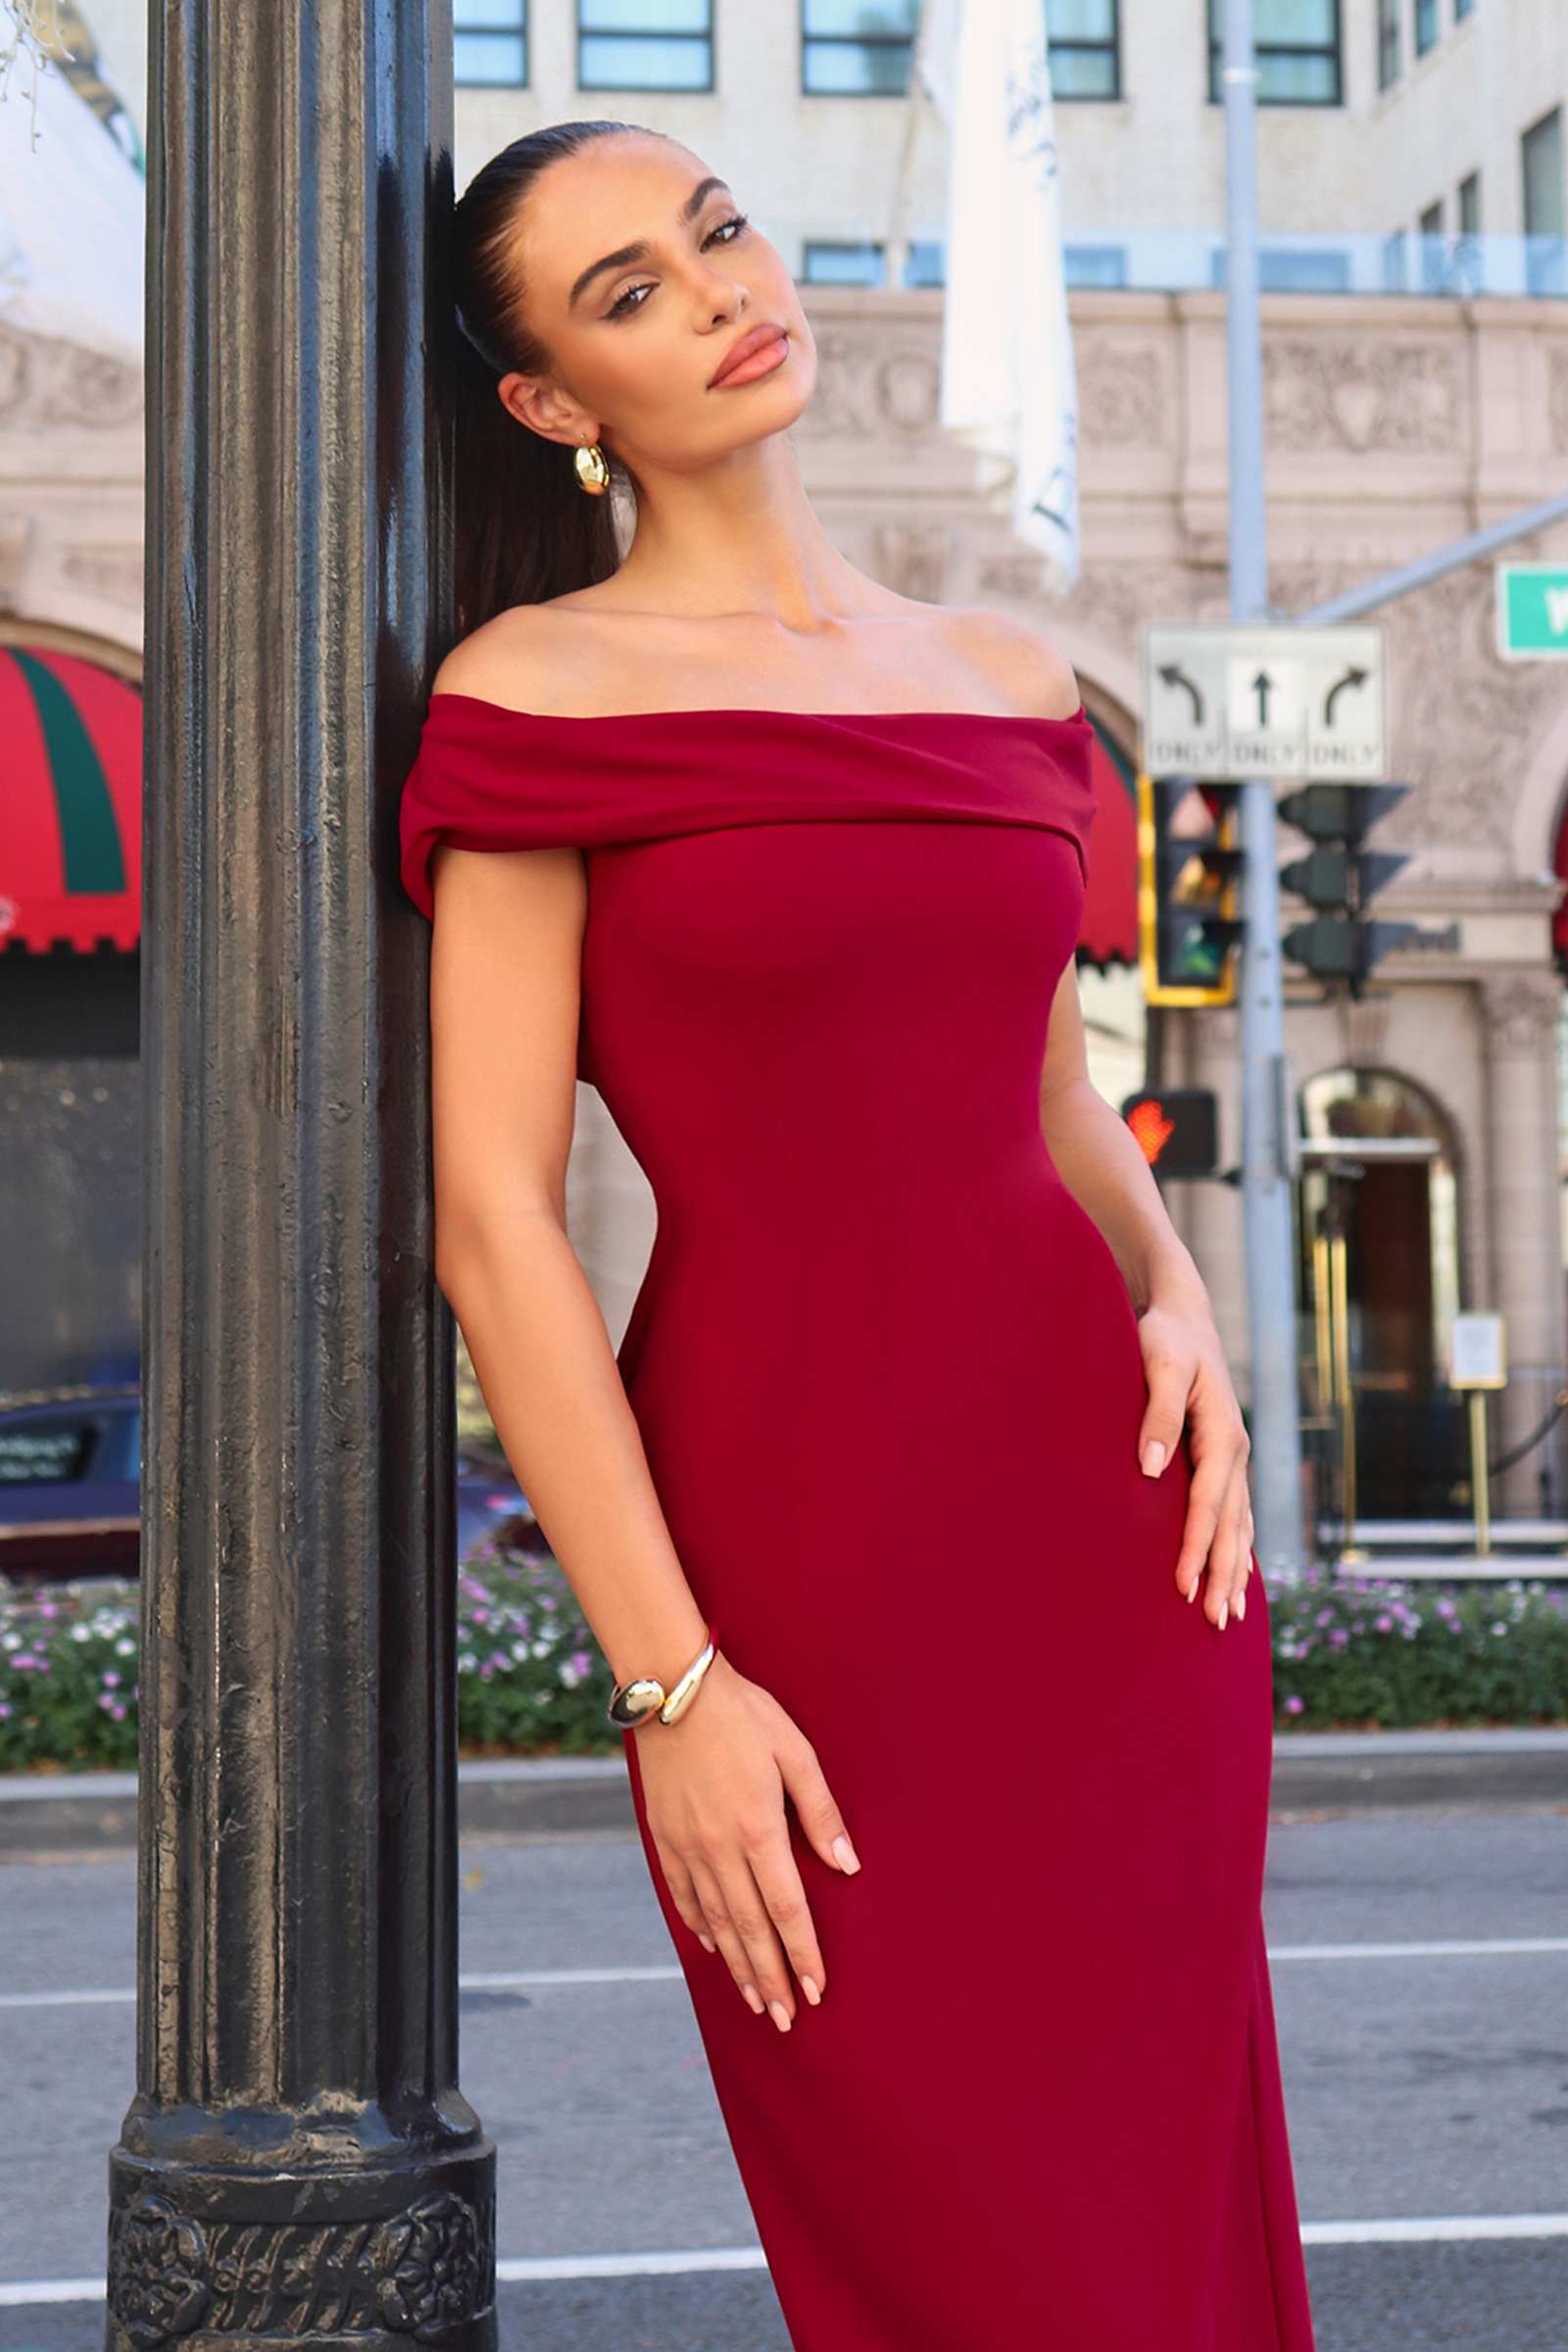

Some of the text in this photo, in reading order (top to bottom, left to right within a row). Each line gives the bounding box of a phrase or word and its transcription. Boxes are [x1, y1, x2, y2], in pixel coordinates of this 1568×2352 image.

[1156, 741, 1221, 764] ONLY
[1234, 741, 1298, 764] ONLY
[1313, 741, 1379, 764] ONLY
